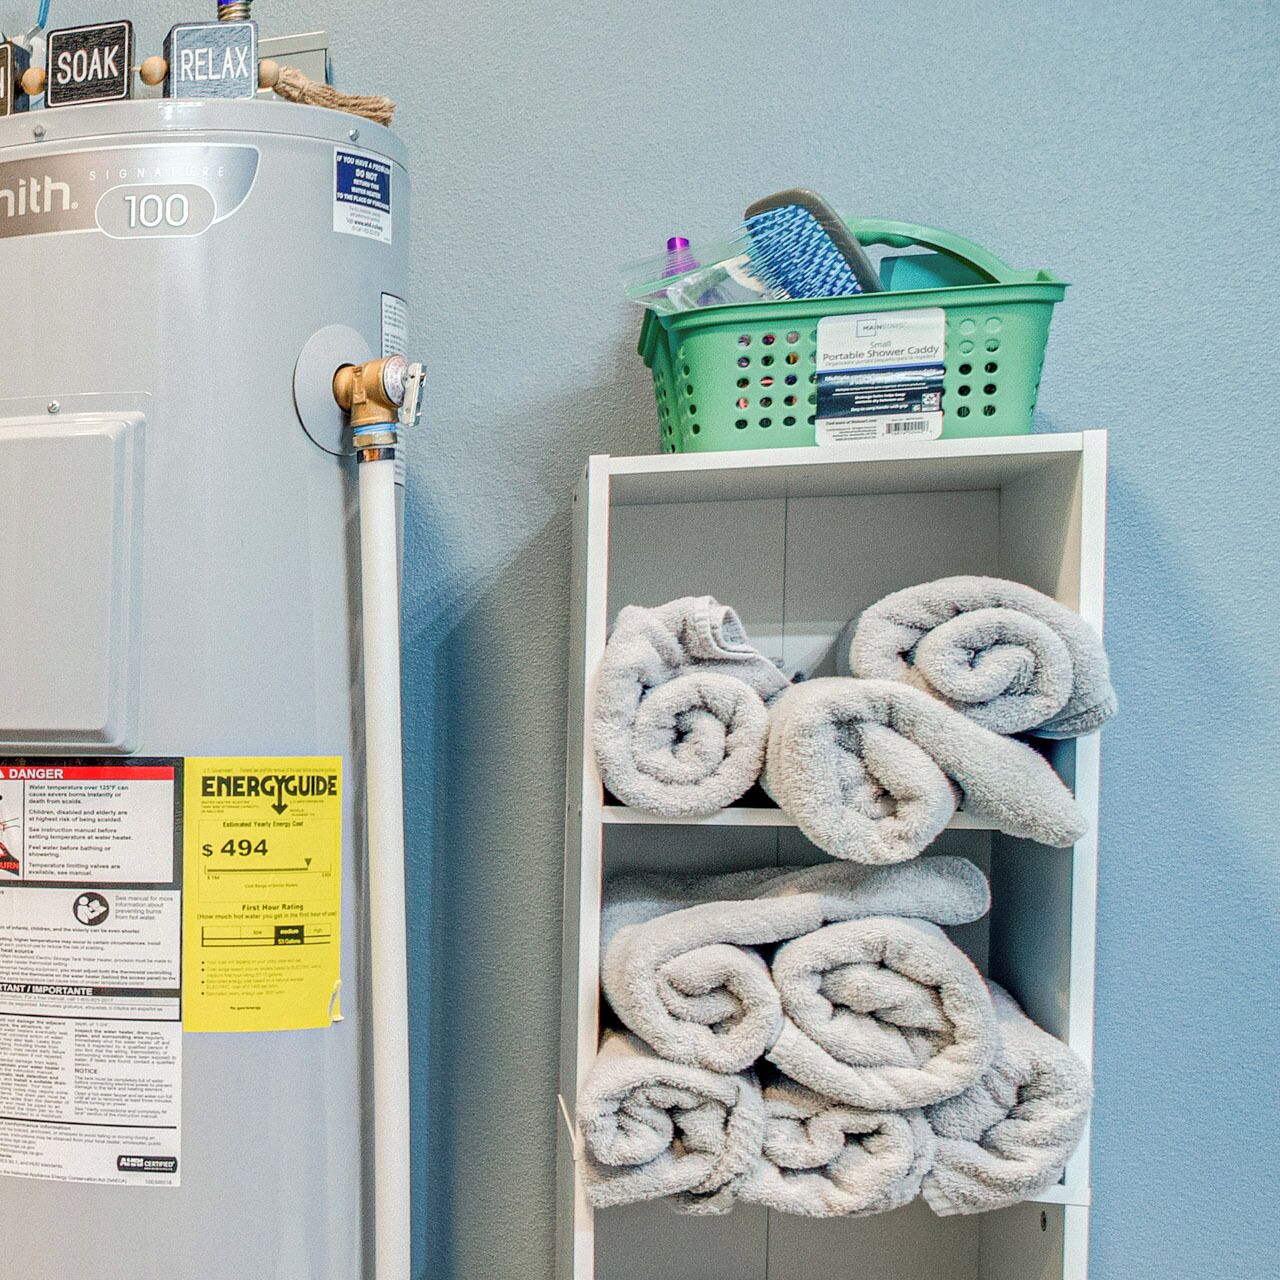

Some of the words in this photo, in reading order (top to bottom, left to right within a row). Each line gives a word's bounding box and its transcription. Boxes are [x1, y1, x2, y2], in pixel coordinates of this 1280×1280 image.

[56, 45, 119, 85] SOAK
[180, 46, 249, 81] RELAX
[344, 156, 354, 164] YOU
[355, 159, 368, 168] HAVE
[89, 167, 225, 181] SIGNATURE
[356, 169, 365, 178] DO
[366, 171, 378, 181] NOT
[344, 193, 353, 201] THE
[354, 196, 366, 204] PLACE
[124, 193, 190, 228] 100
[870, 341, 891, 349] Small
[823, 350, 864, 361] Portable
[867, 348, 905, 358] Shower
[908, 345, 939, 355] Caddy
[9, 768, 63, 779] DANGER
[202, 843, 213, 858] $
[220, 839, 268, 857] 494
[282, 903, 304, 911] Rating
[32, 985, 93, 996] IMPORTANTE
